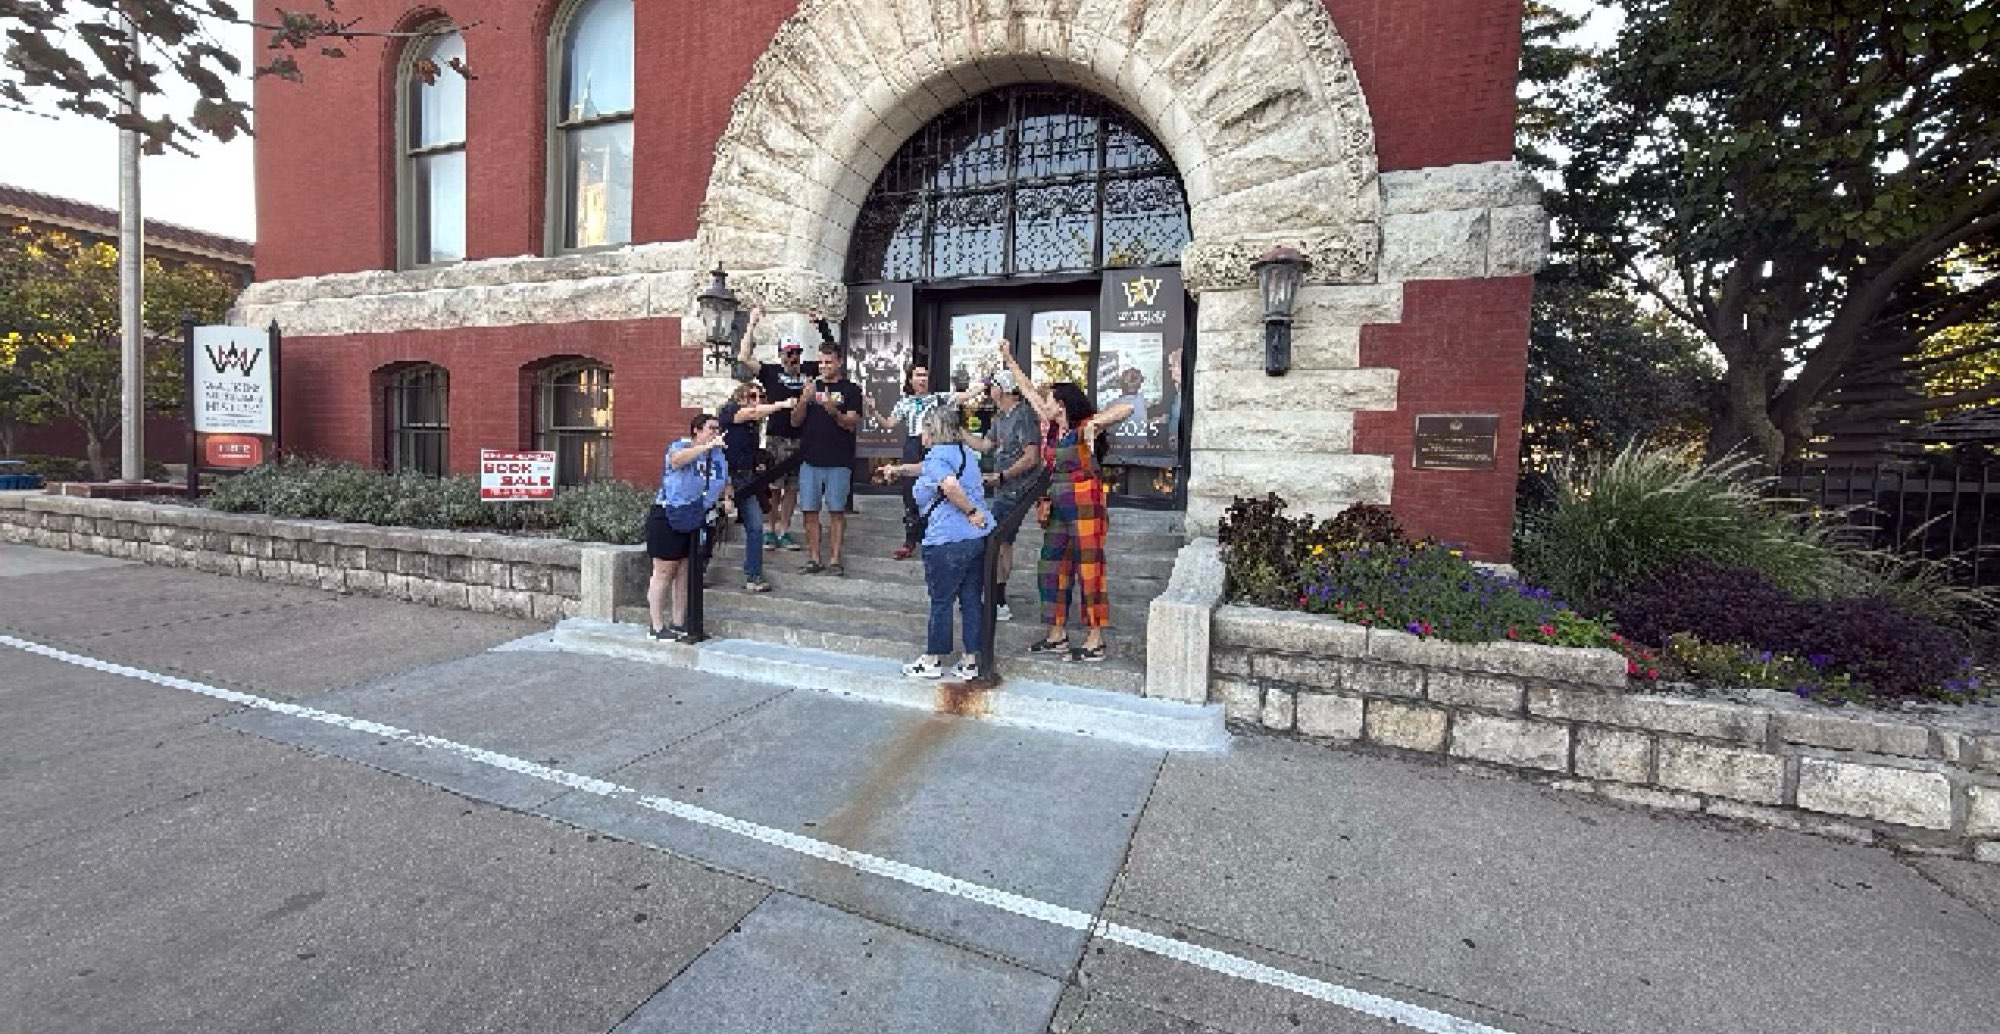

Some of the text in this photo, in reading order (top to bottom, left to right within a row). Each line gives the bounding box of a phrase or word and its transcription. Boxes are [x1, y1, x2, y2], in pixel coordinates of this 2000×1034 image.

[1115, 419, 1160, 437] 2025
[483, 463, 532, 474] BOOK
[500, 475, 551, 487] SALE
